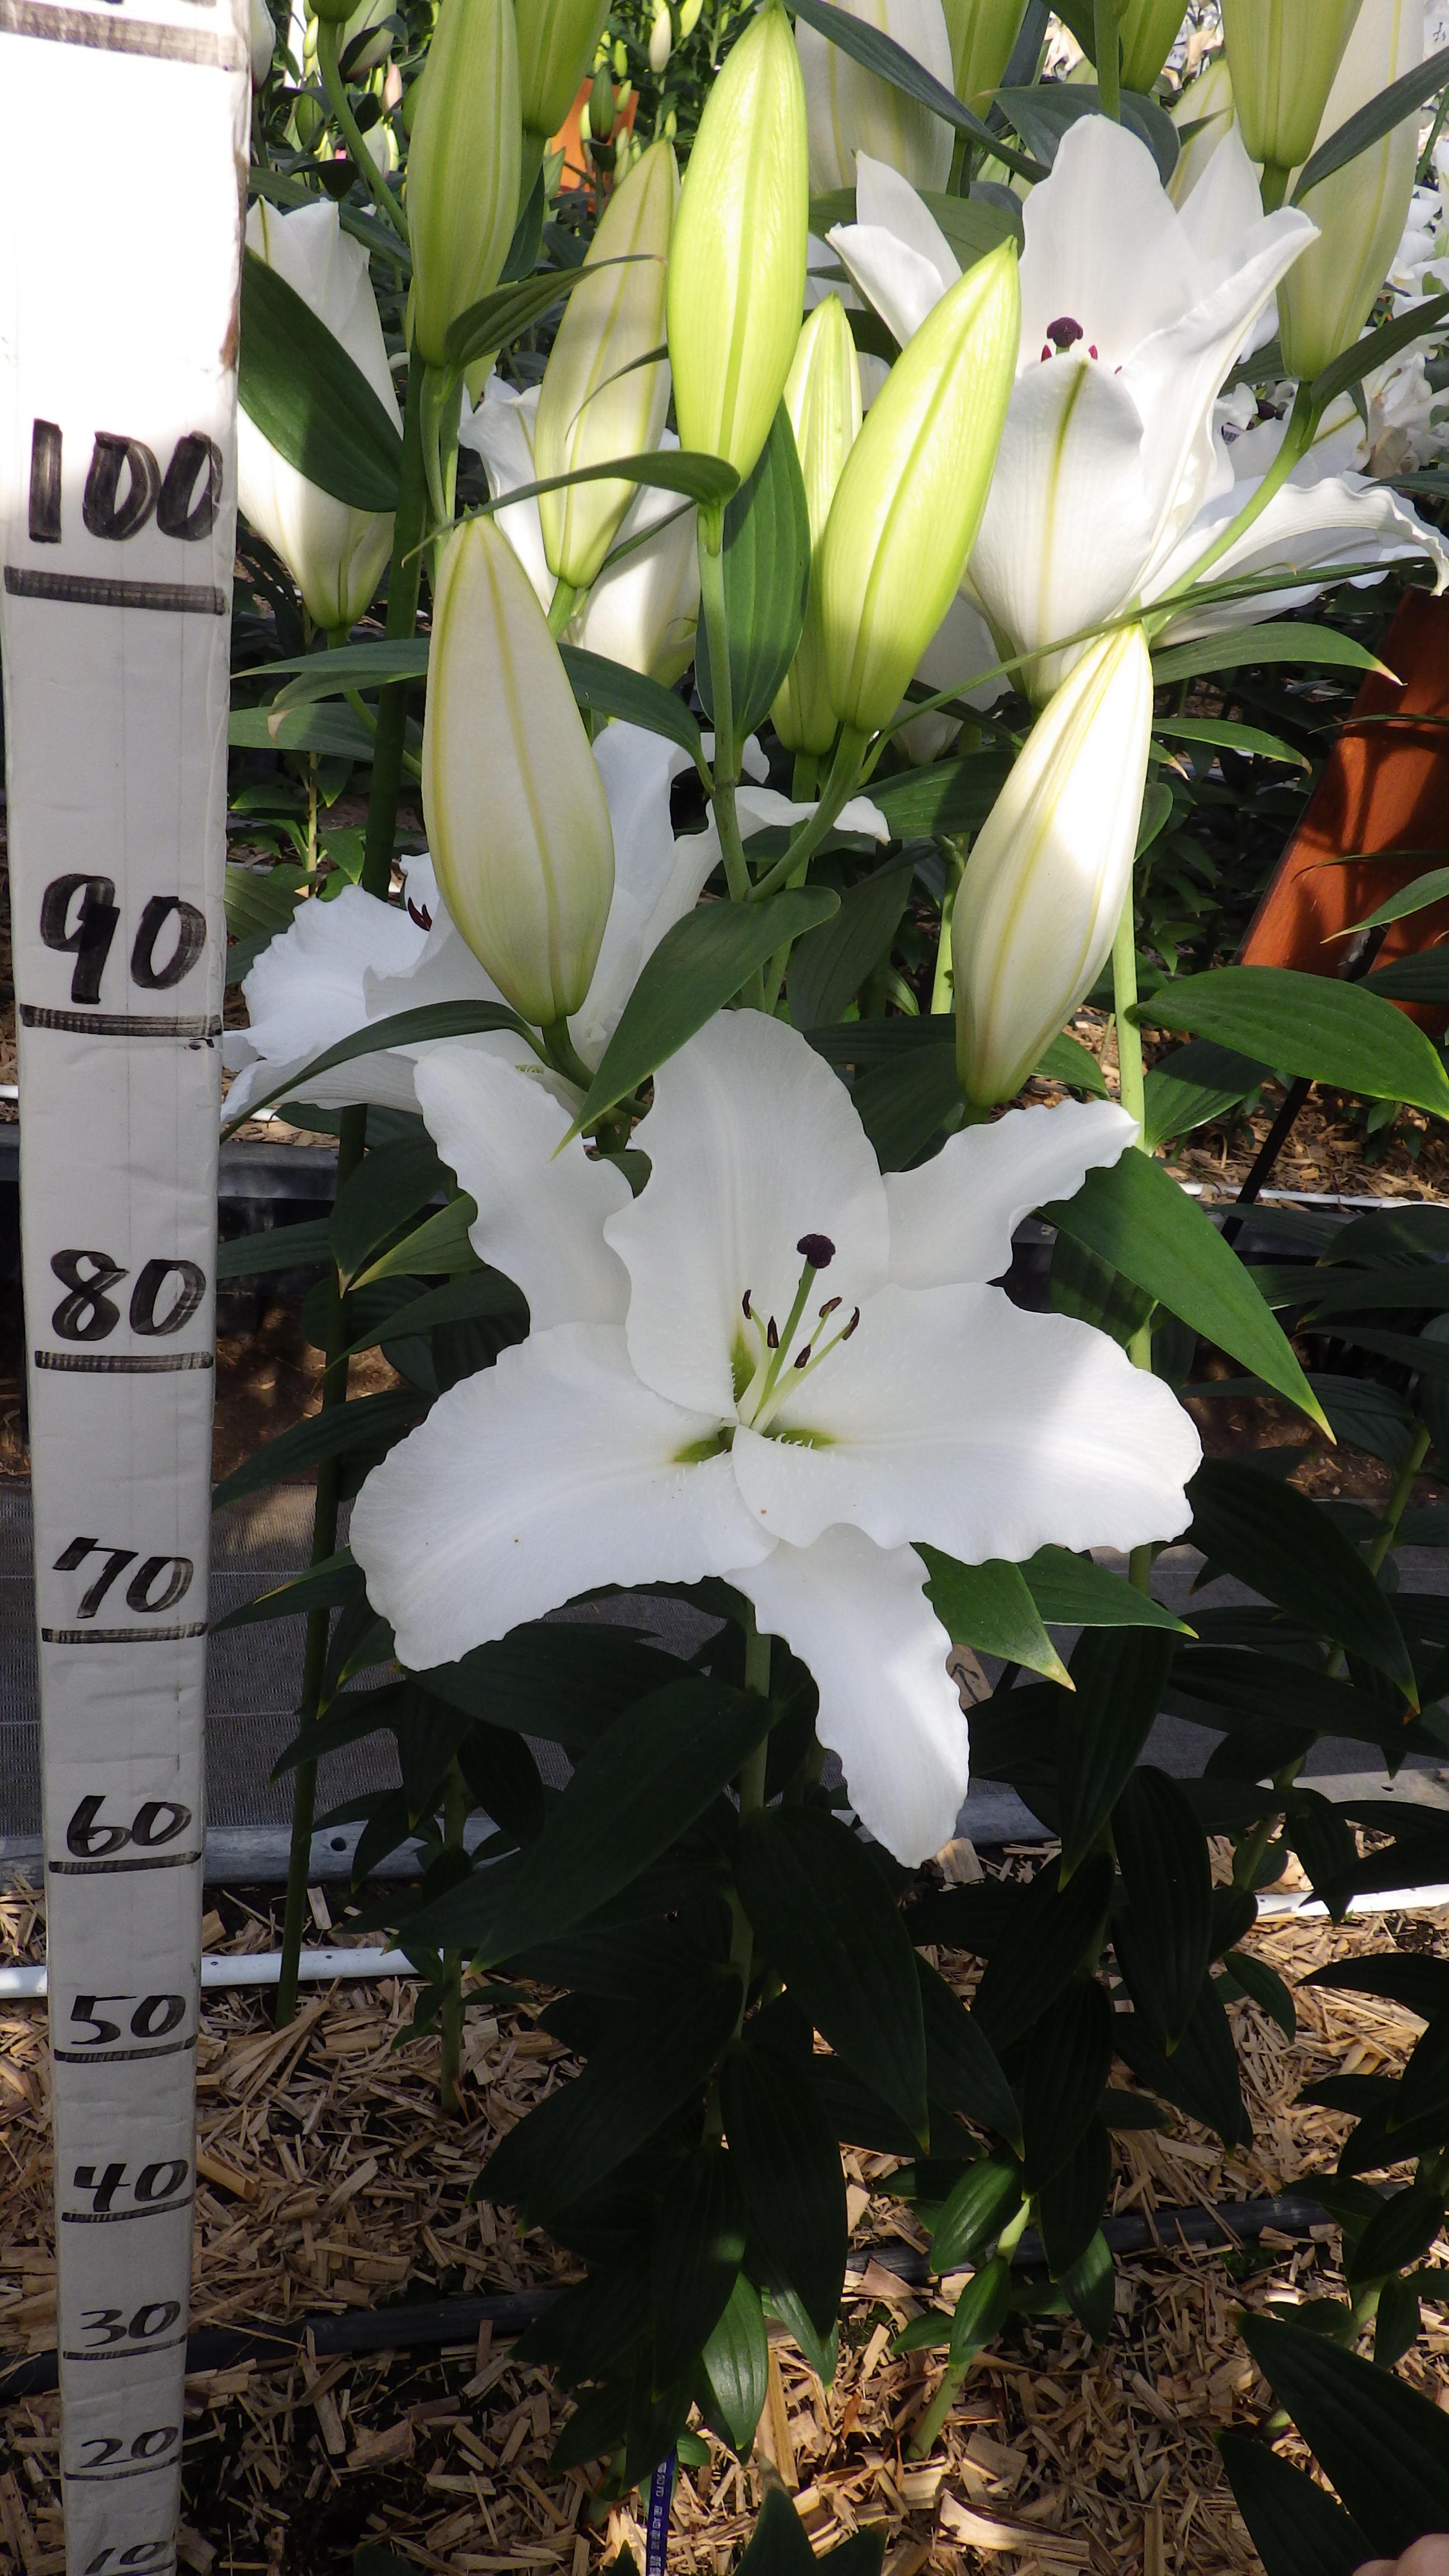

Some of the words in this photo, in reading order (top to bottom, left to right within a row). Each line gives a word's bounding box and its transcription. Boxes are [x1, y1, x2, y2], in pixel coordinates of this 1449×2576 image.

[29, 418, 223, 543] 100
[40, 873, 206, 1004] 90
[51, 1249, 207, 1341] 80
[52, 1537, 194, 1618] 70
[67, 1795, 192, 1857] 60
[70, 1995, 186, 2045] 50
[73, 2159, 188, 2212] 40
[80, 2300, 181, 2347] 30
[80, 2426, 178, 2468] 20
[84, 2540, 167, 2574] 10
